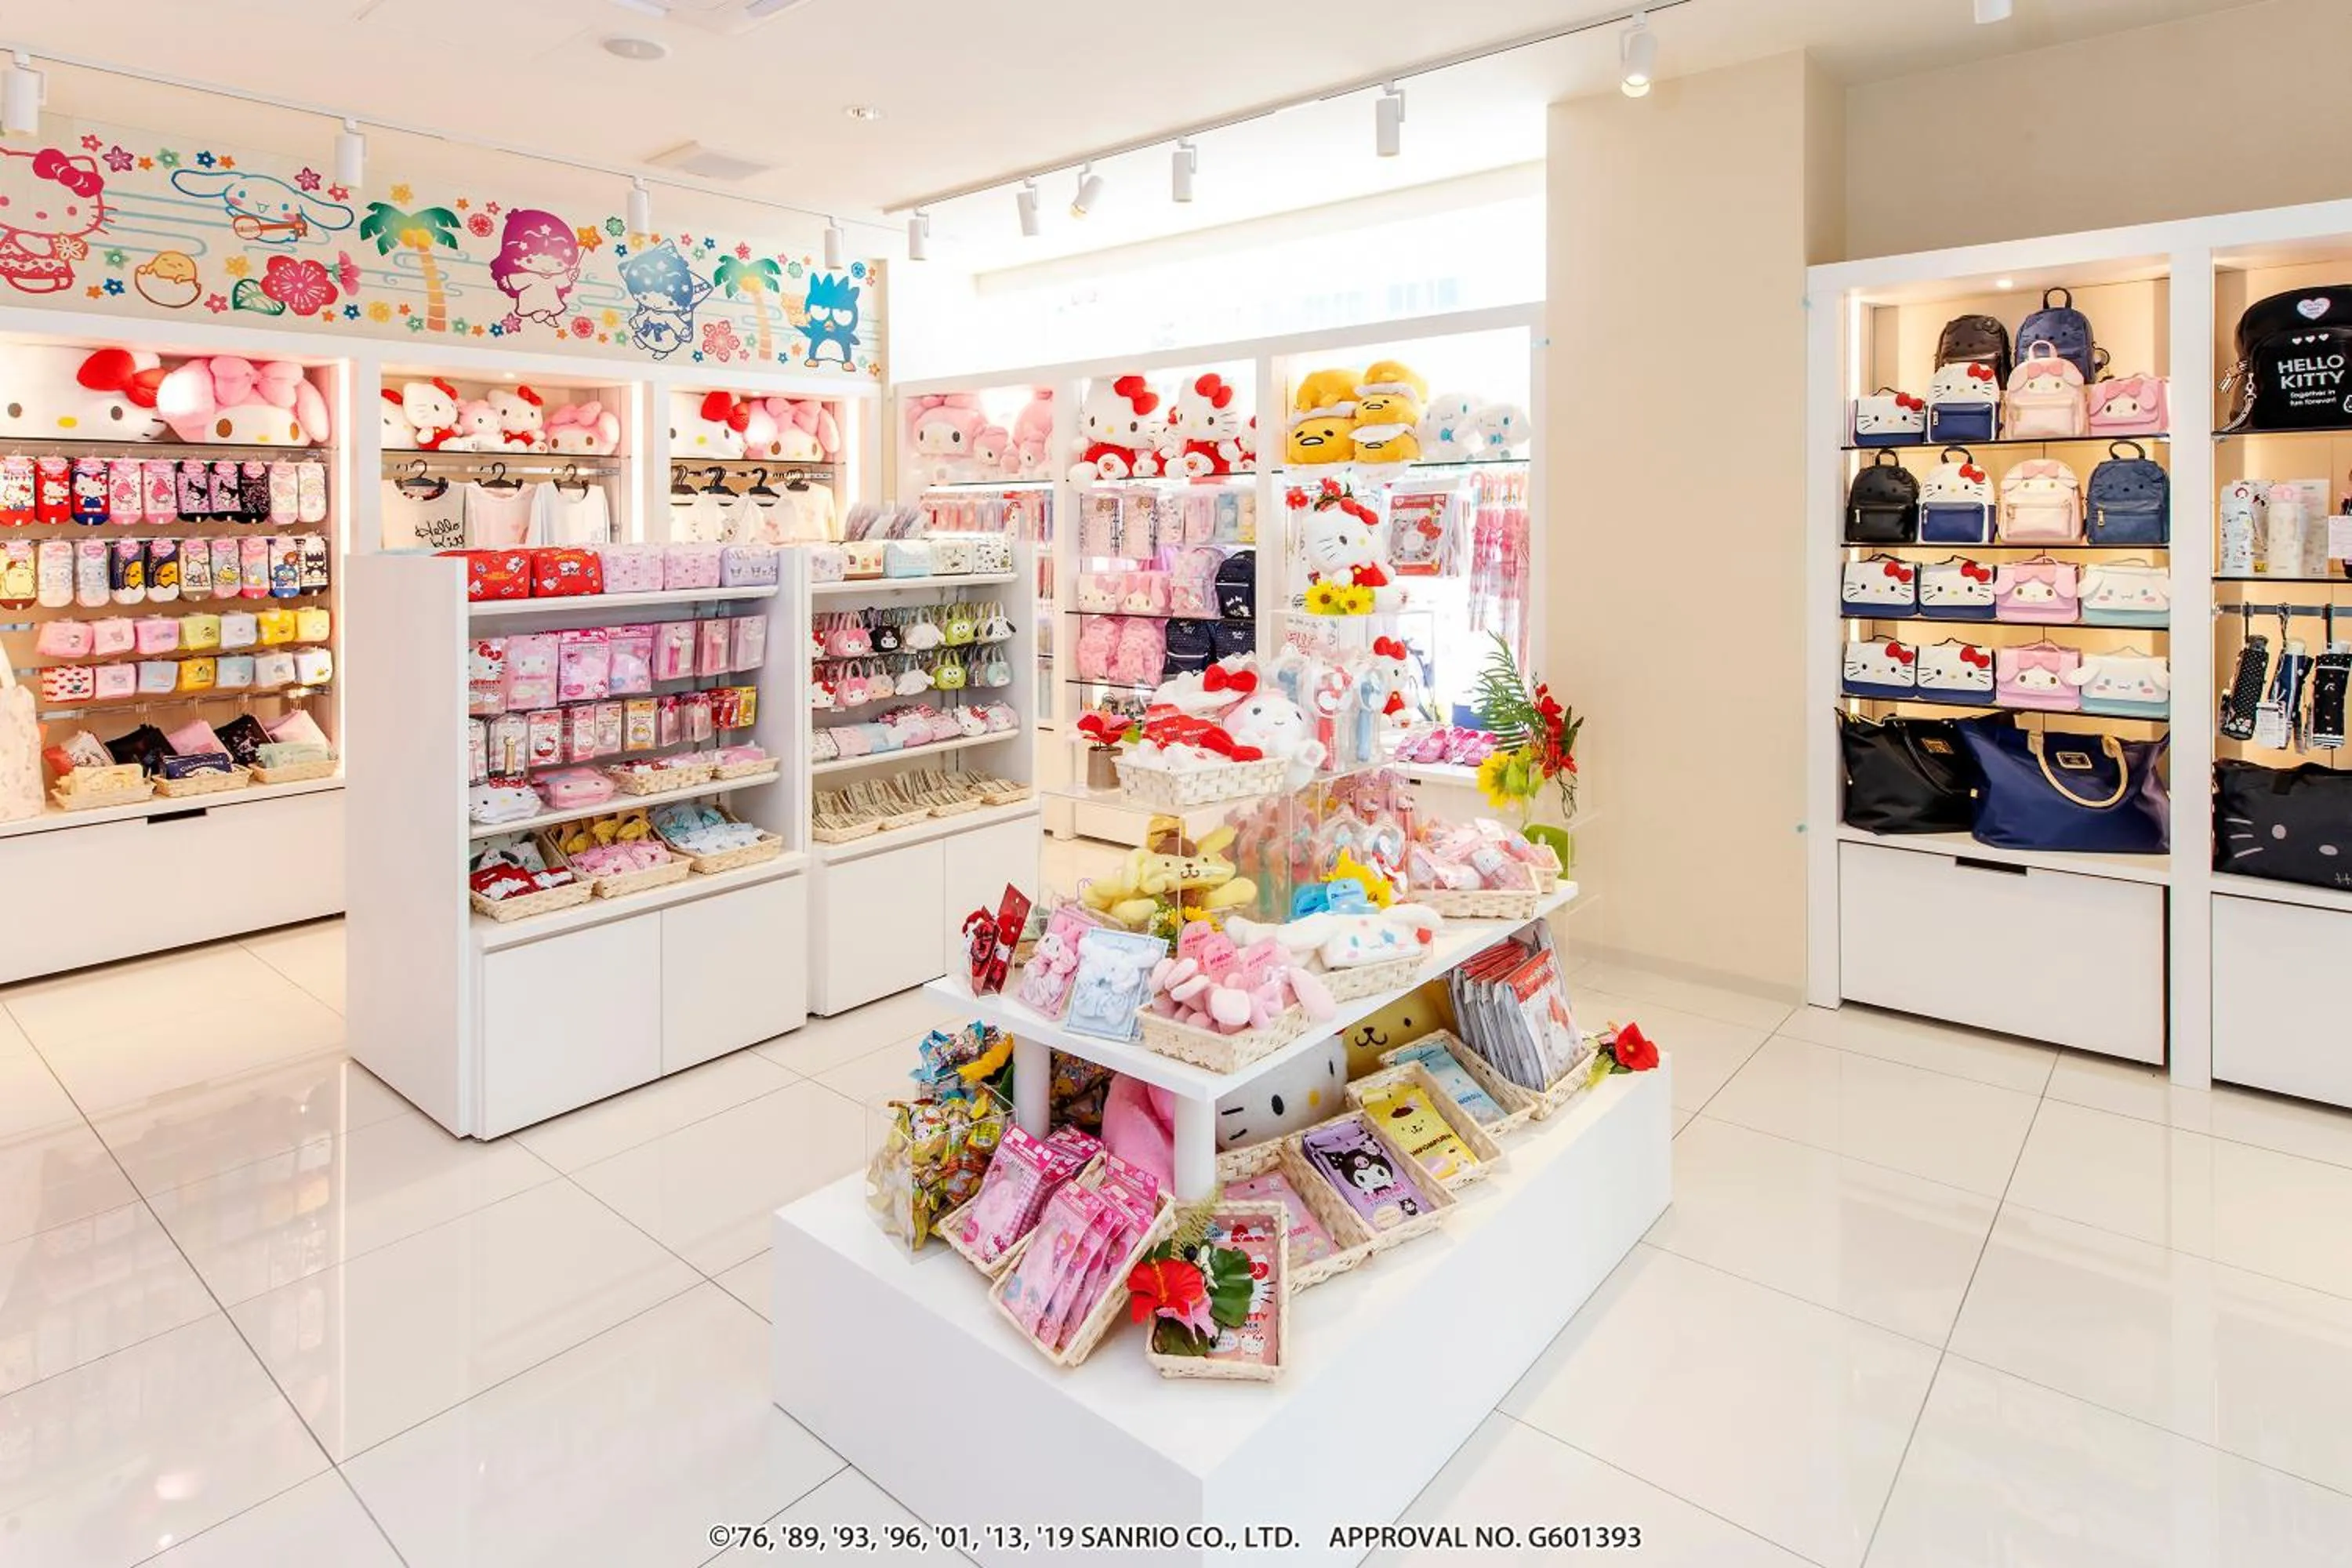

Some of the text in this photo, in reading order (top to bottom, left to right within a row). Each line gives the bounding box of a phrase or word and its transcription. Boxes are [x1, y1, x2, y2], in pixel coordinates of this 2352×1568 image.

[2278, 354, 2345, 374] HELLO
[2281, 369, 2345, 390] KITTY
[415, 517, 460, 538] Hello
